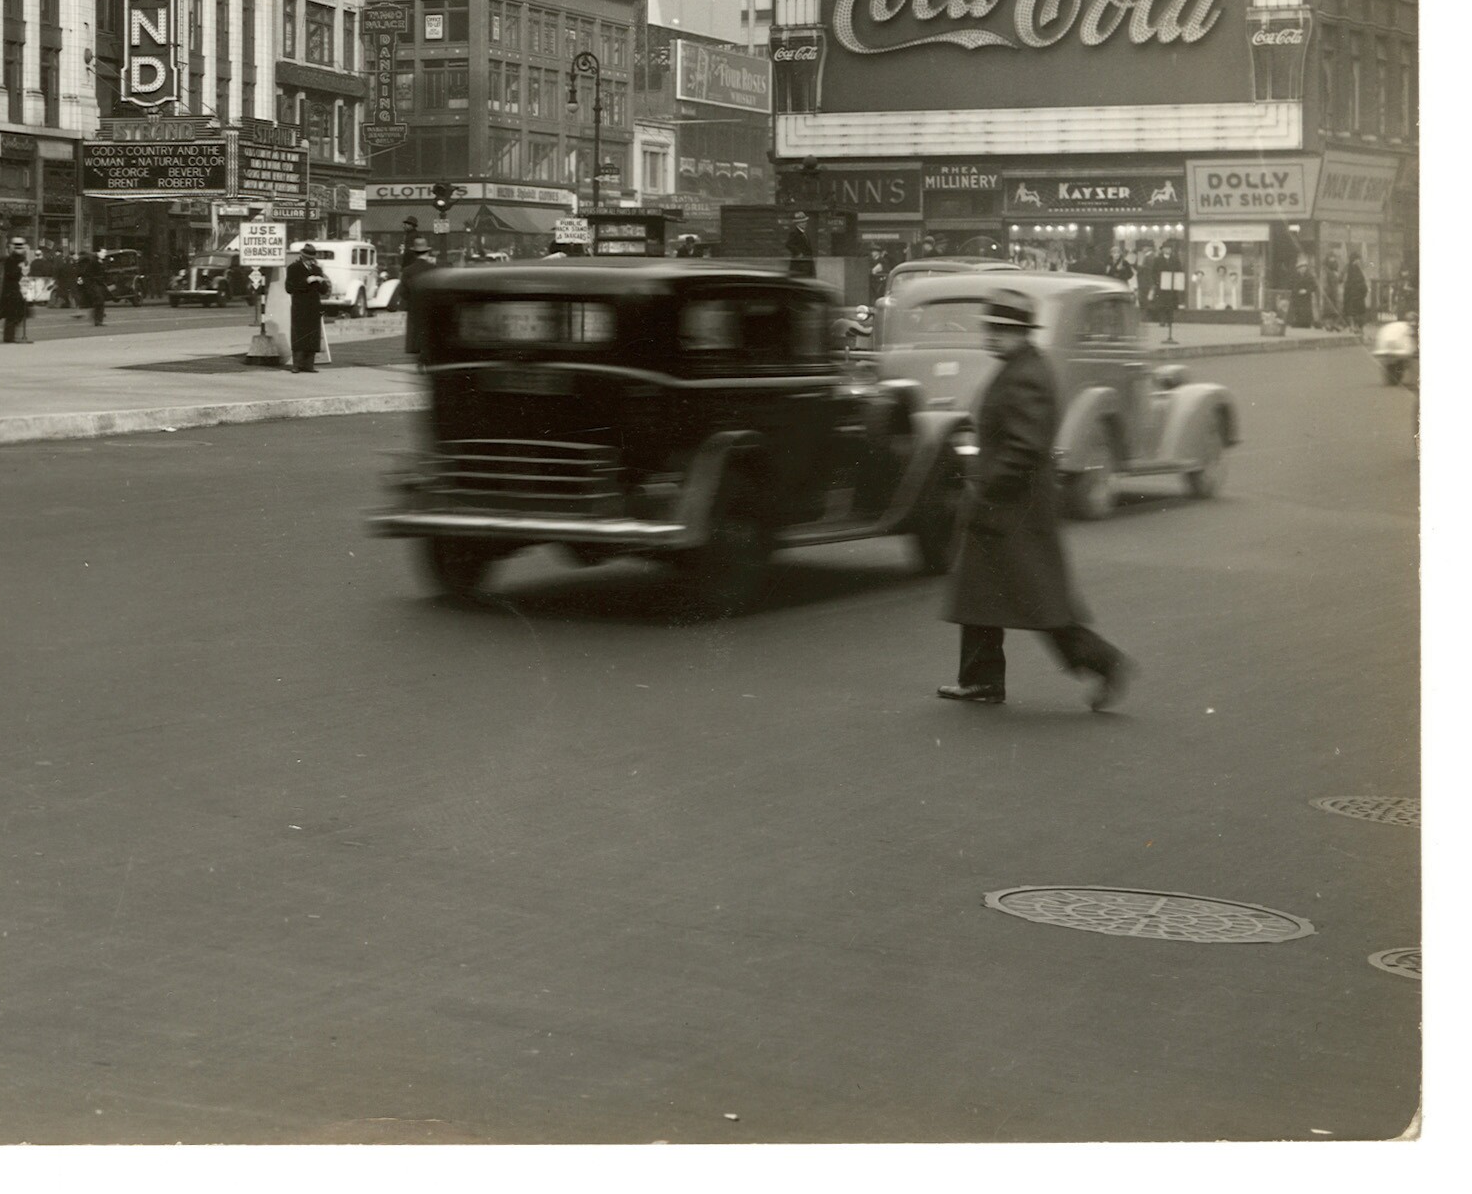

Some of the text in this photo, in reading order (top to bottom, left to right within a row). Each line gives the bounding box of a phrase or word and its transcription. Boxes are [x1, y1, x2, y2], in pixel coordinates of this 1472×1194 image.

[379, 34, 391, 122] DANCING
[112, 122, 196, 141] STRAND
[126, 146, 220, 156] COUNTRY AND THE
[84, 157, 225, 166] WOMAN NATURAL COLOR
[108, 168, 150, 177] GEORGE
[168, 168, 212, 177] BEVERLY
[941, 166, 978, 174] RHEA
[108, 178, 205, 188] BRENT ROBERTS
[925, 175, 998, 189] MILLINERY
[1208, 172, 1289, 189] DOLLY
[1200, 193, 1299, 207] HAT SHOPS
[273, 208, 316, 218] BILLIARS
[250, 226, 277, 235] USE
[244, 237, 283, 246] LITTER CAN
[252, 247, 283, 256] BASKET
